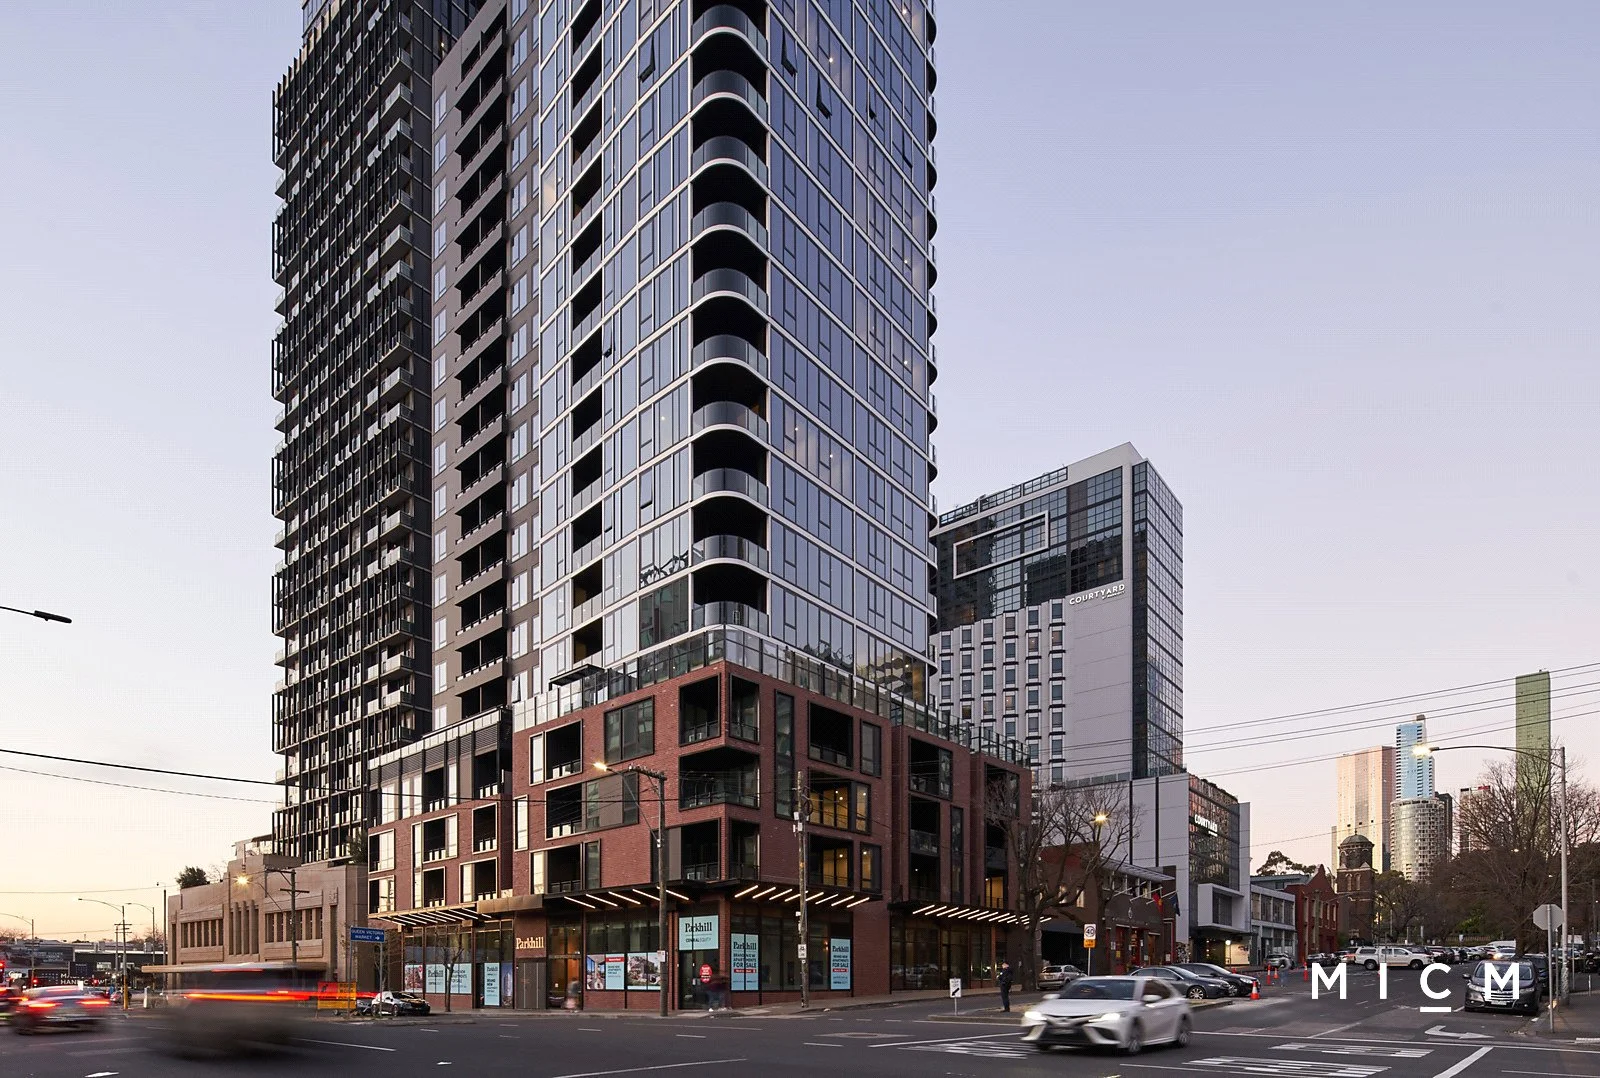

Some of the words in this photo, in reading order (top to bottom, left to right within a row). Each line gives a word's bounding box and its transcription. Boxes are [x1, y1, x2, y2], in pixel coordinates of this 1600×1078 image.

[1069, 583, 1125, 605] COURTYARD
[685, 922, 712, 933] Parkhill
[515, 936, 545, 950] Parkhill
